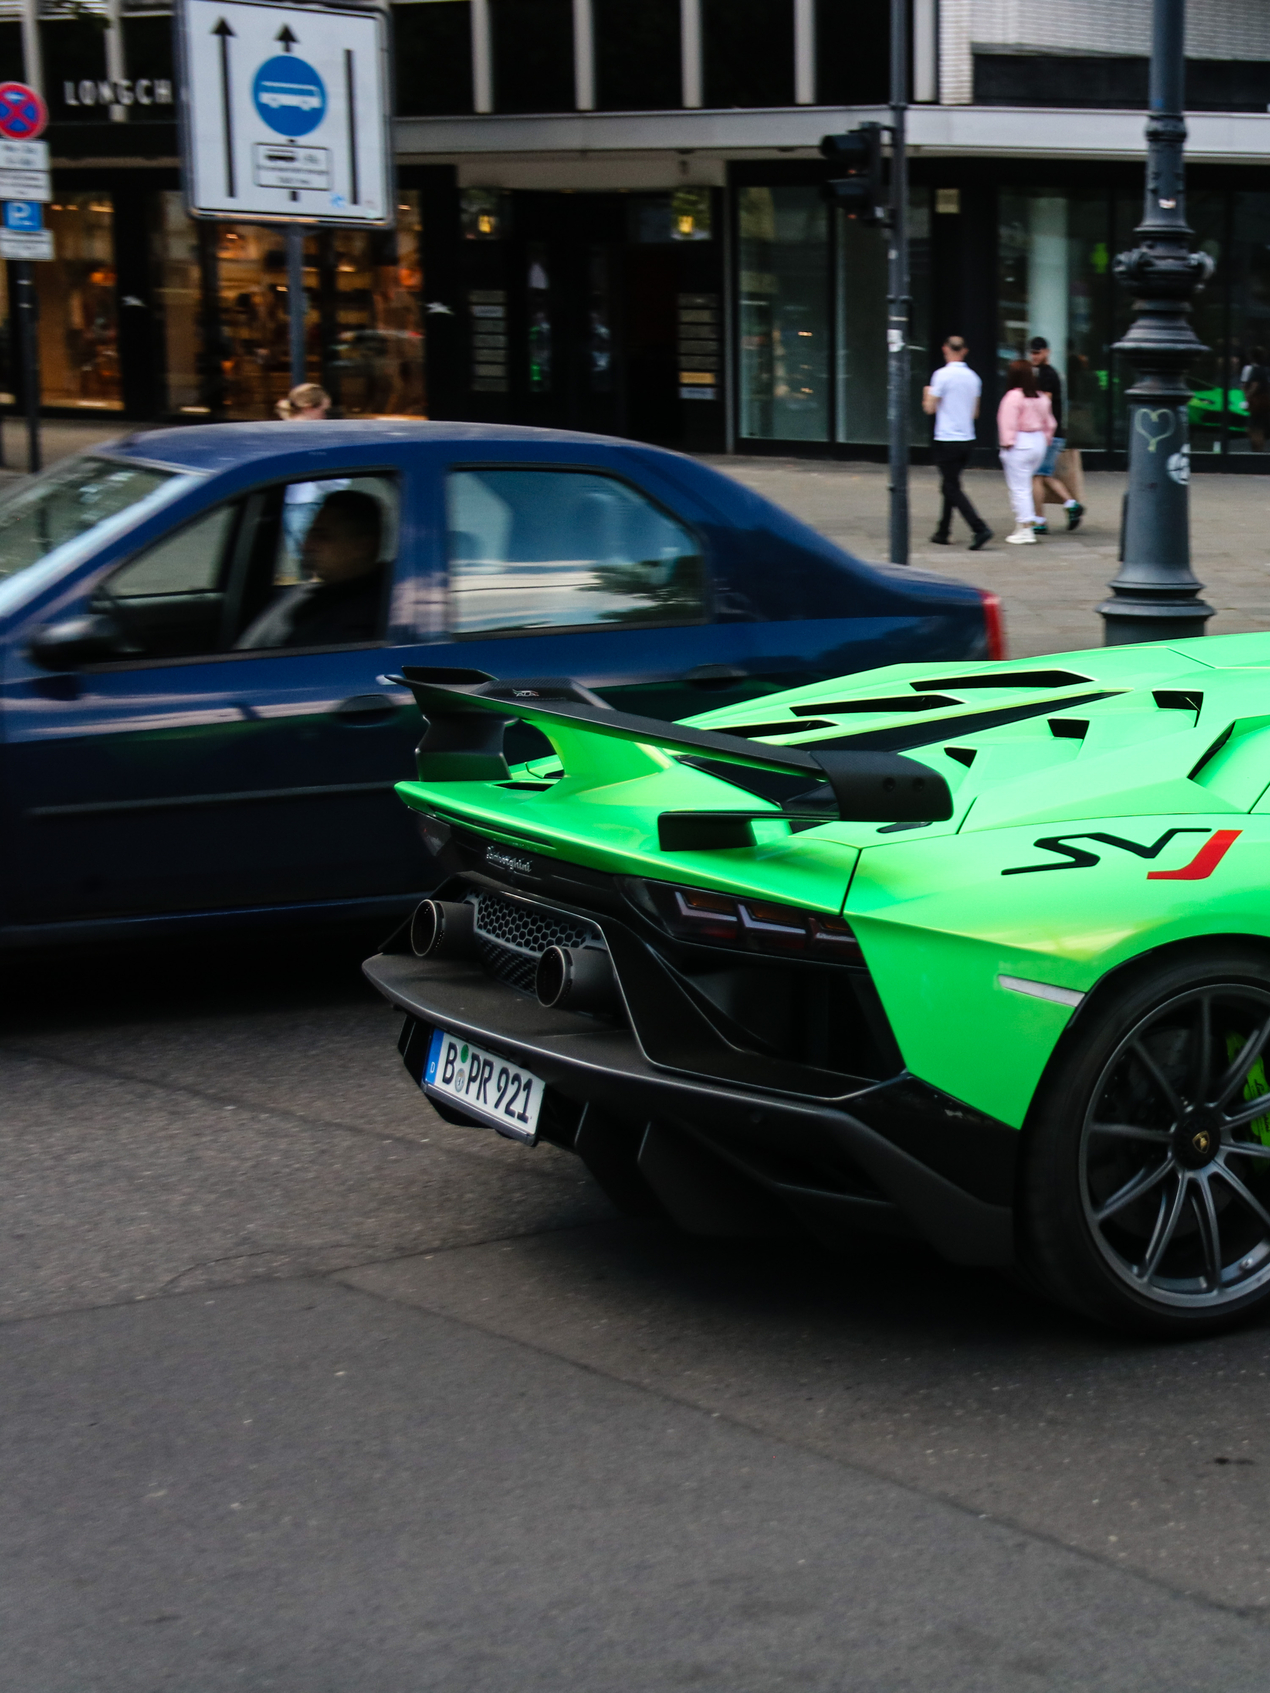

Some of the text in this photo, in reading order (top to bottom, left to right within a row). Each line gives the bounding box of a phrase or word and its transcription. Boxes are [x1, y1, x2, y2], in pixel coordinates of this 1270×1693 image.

[486, 845, 533, 873] Lamborghini
[1001, 828, 1243, 881] SVJ
[442, 1041, 534, 1124] B PR 921
